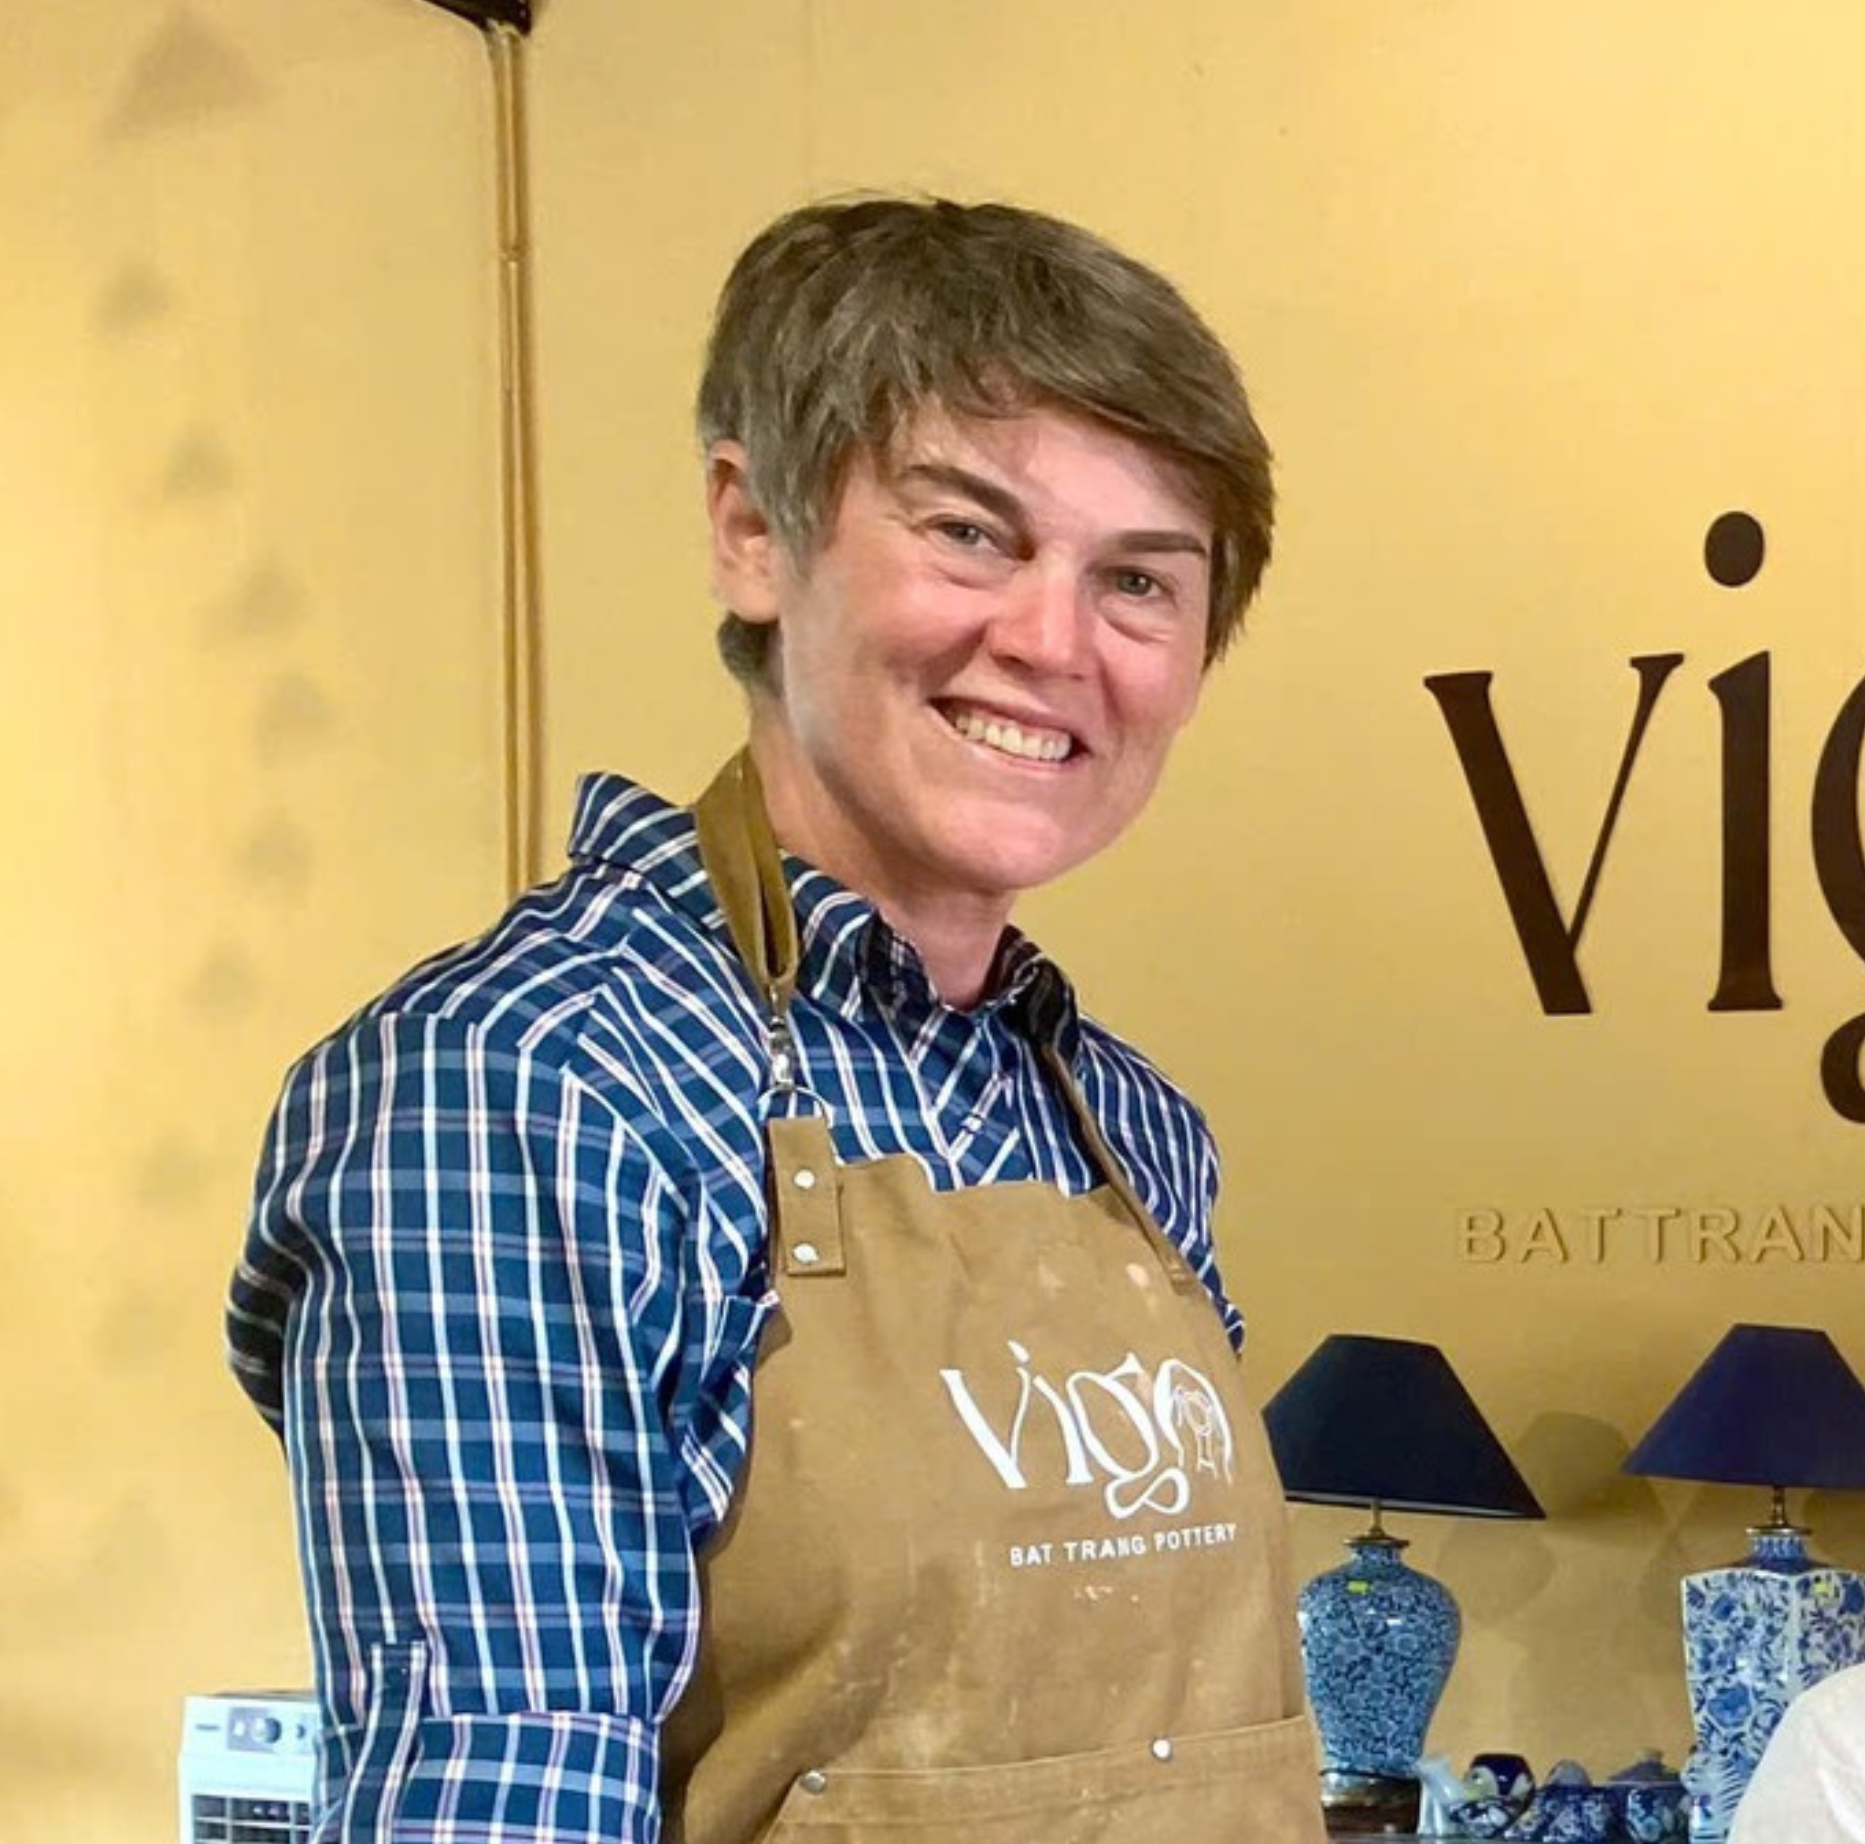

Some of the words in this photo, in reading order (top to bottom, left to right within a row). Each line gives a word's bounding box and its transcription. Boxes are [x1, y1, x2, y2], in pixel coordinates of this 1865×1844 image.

[940, 1340, 1233, 1519] vigo
[1010, 1544, 1053, 1567] BAT
[1063, 1535, 1147, 1561] TRANG
[1154, 1523, 1237, 1552] POTTERY
